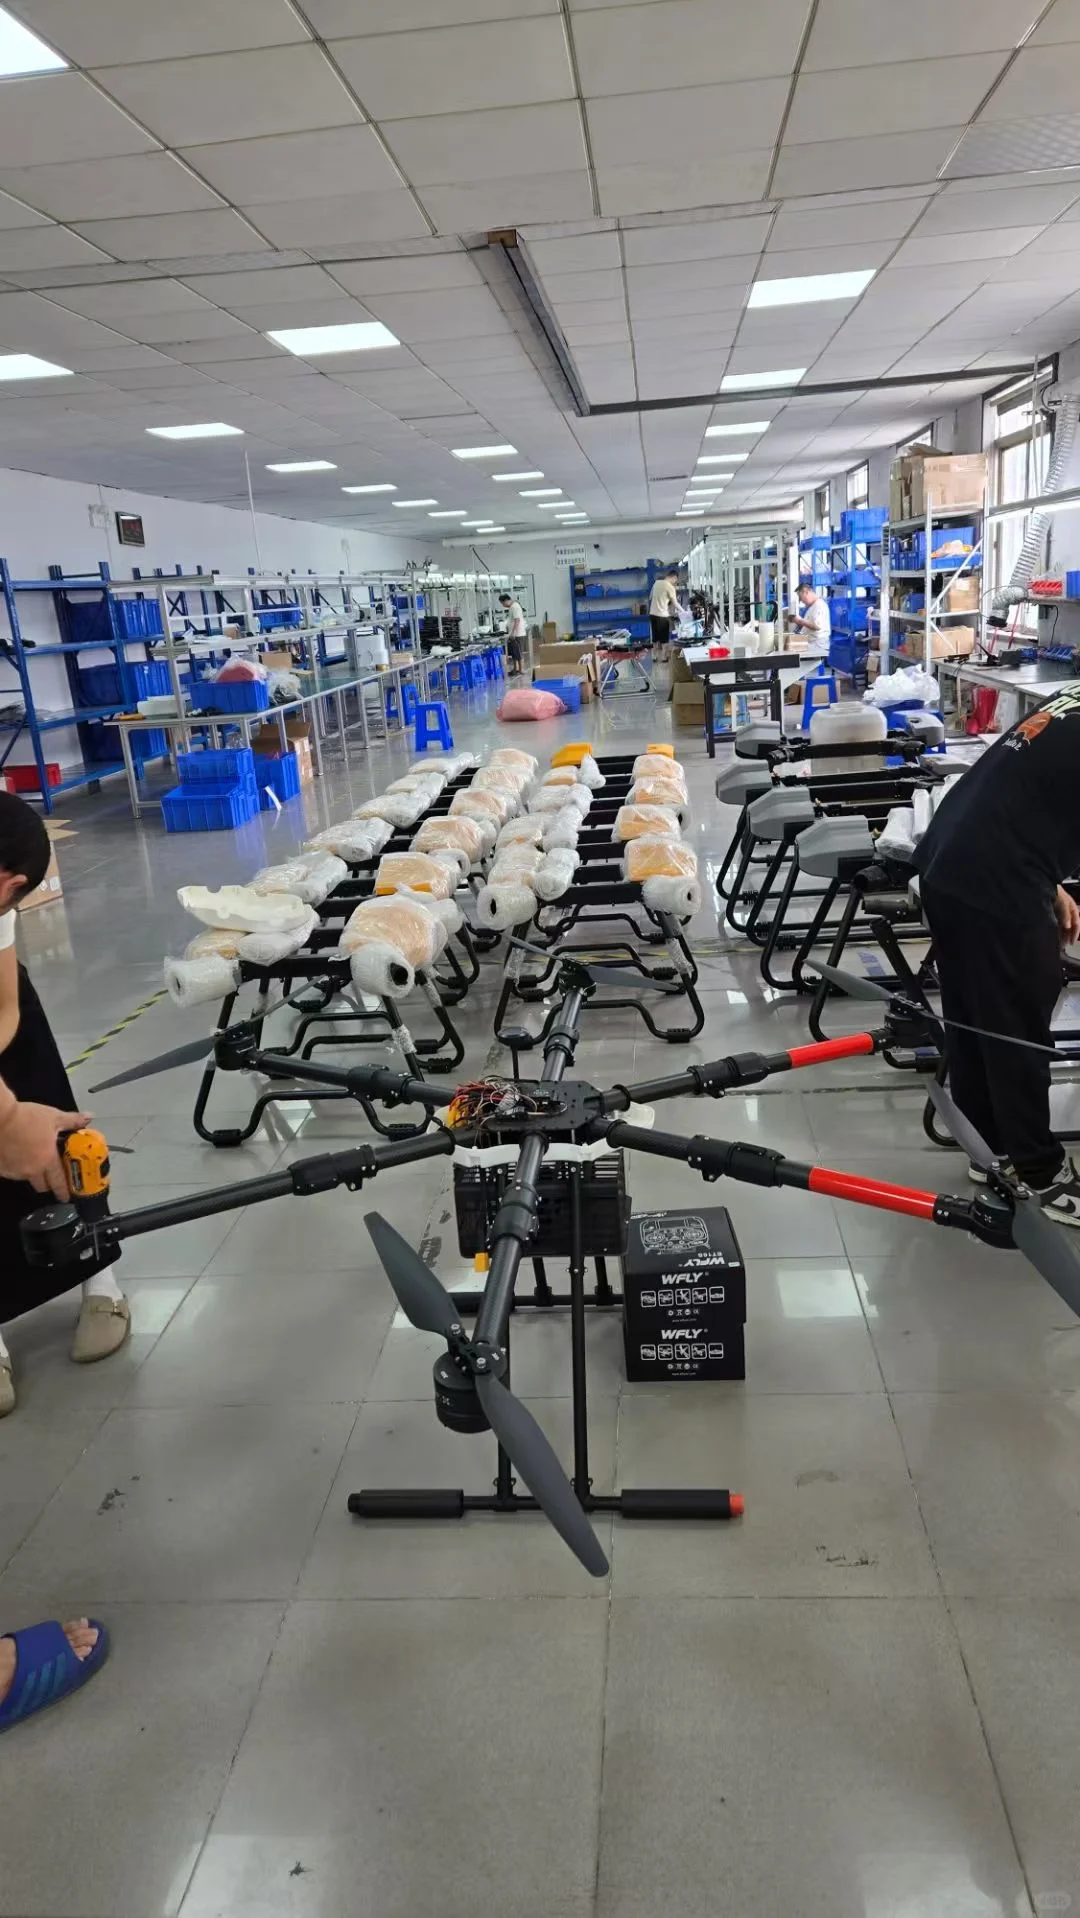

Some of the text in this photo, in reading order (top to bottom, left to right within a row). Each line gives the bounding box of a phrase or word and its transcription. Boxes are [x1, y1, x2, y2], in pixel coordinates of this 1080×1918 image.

[683, 1257, 725, 1267] WFLY
[661, 1273, 703, 1285] WFLY
[661, 1329, 703, 1340] WFLY
